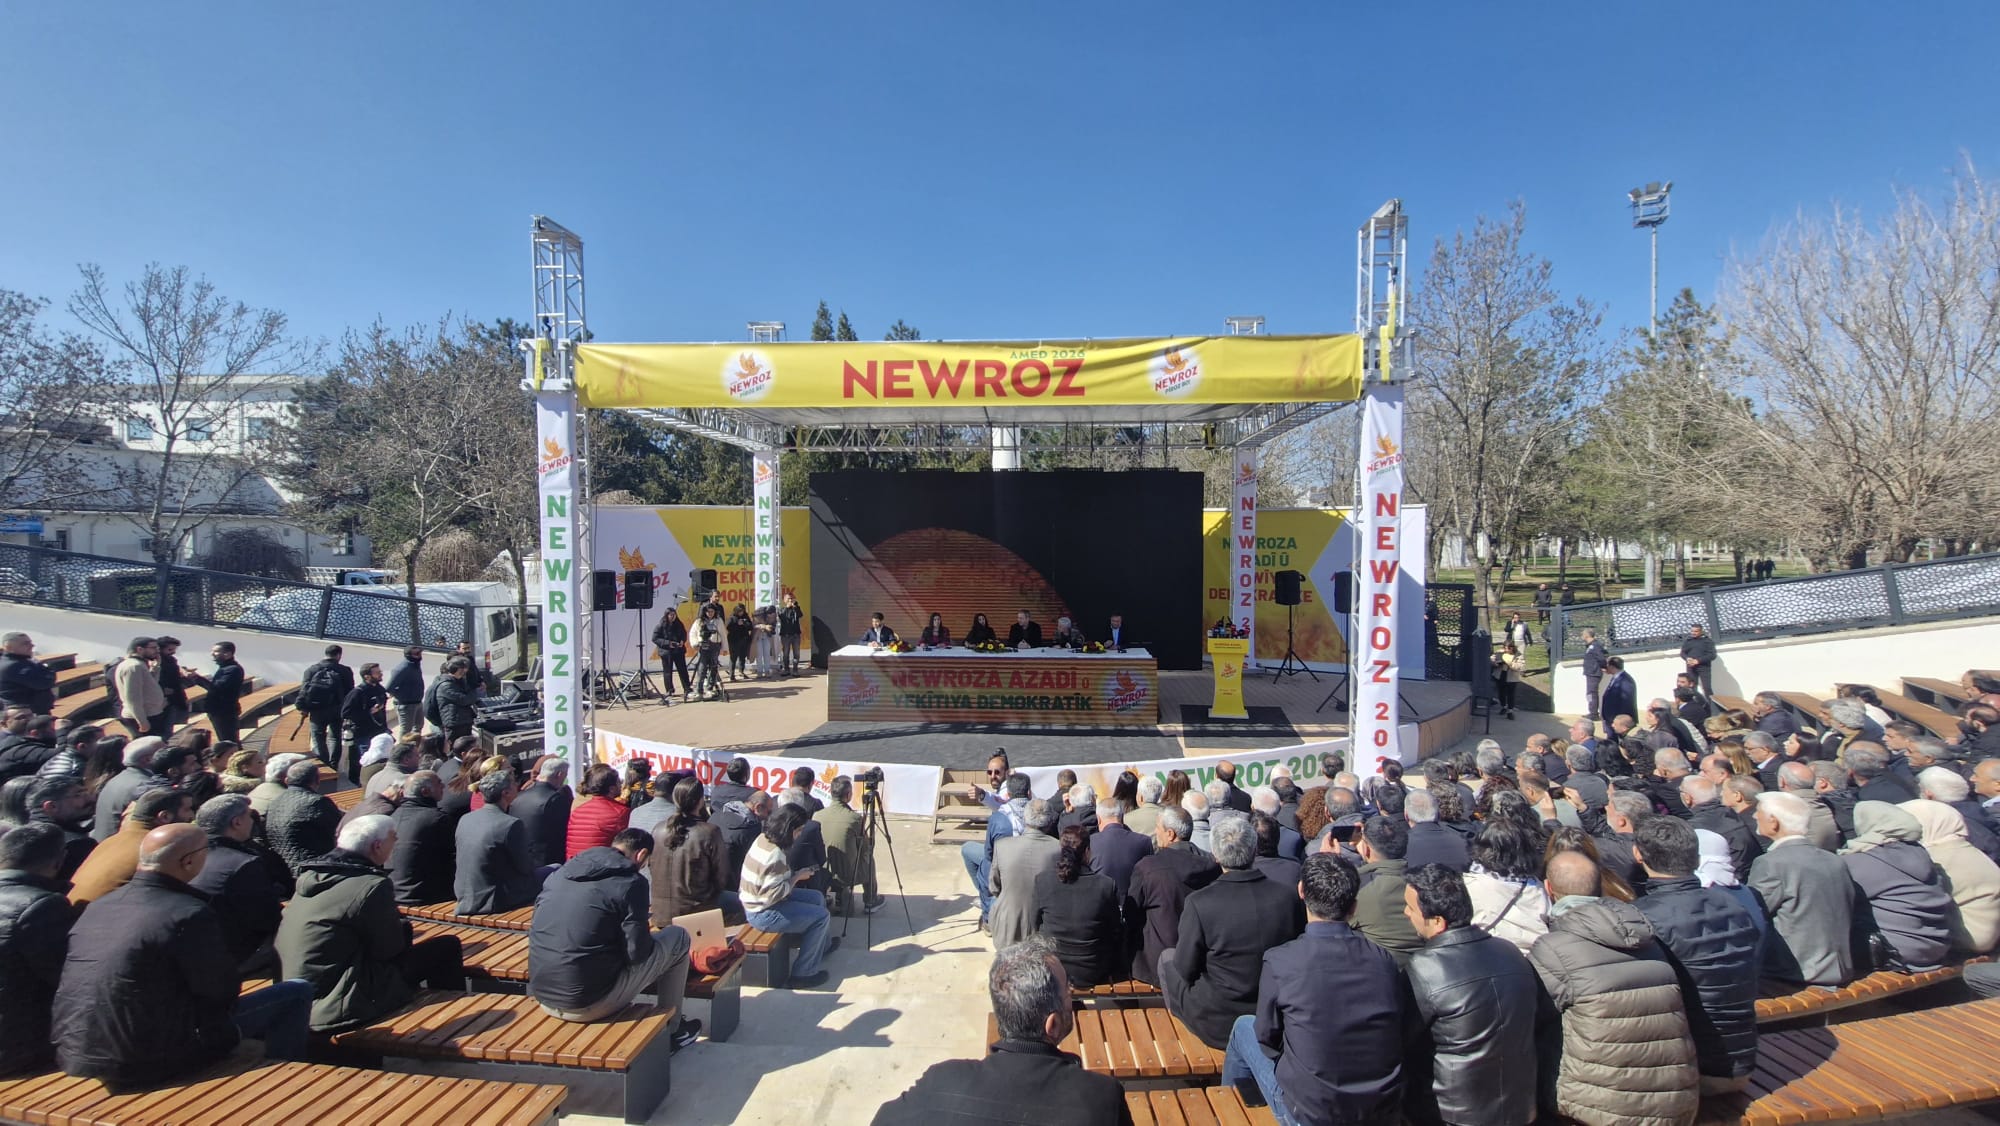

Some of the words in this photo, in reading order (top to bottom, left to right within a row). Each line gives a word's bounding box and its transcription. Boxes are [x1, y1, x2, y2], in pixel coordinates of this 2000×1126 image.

[1010, 350, 1048, 359] AMED
[1052, 350, 1086, 359] 2026
[730, 370, 772, 395] NEWROZ
[843, 358, 1086, 399] NEWROZ
[1155, 366, 1198, 391] NEWROZ
[712, 552, 756, 566] AZAD
[757, 496, 773, 603] NEWROZ
[1239, 497, 1255, 606] NEWROZ
[543, 494, 572, 677] NEWROZ
[1369, 493, 1399, 683] NEWROZ
[891, 670, 1003, 688] NEWROZA
[1107, 688, 1148, 711] NEWROZ
[554, 694, 568, 759] 202
